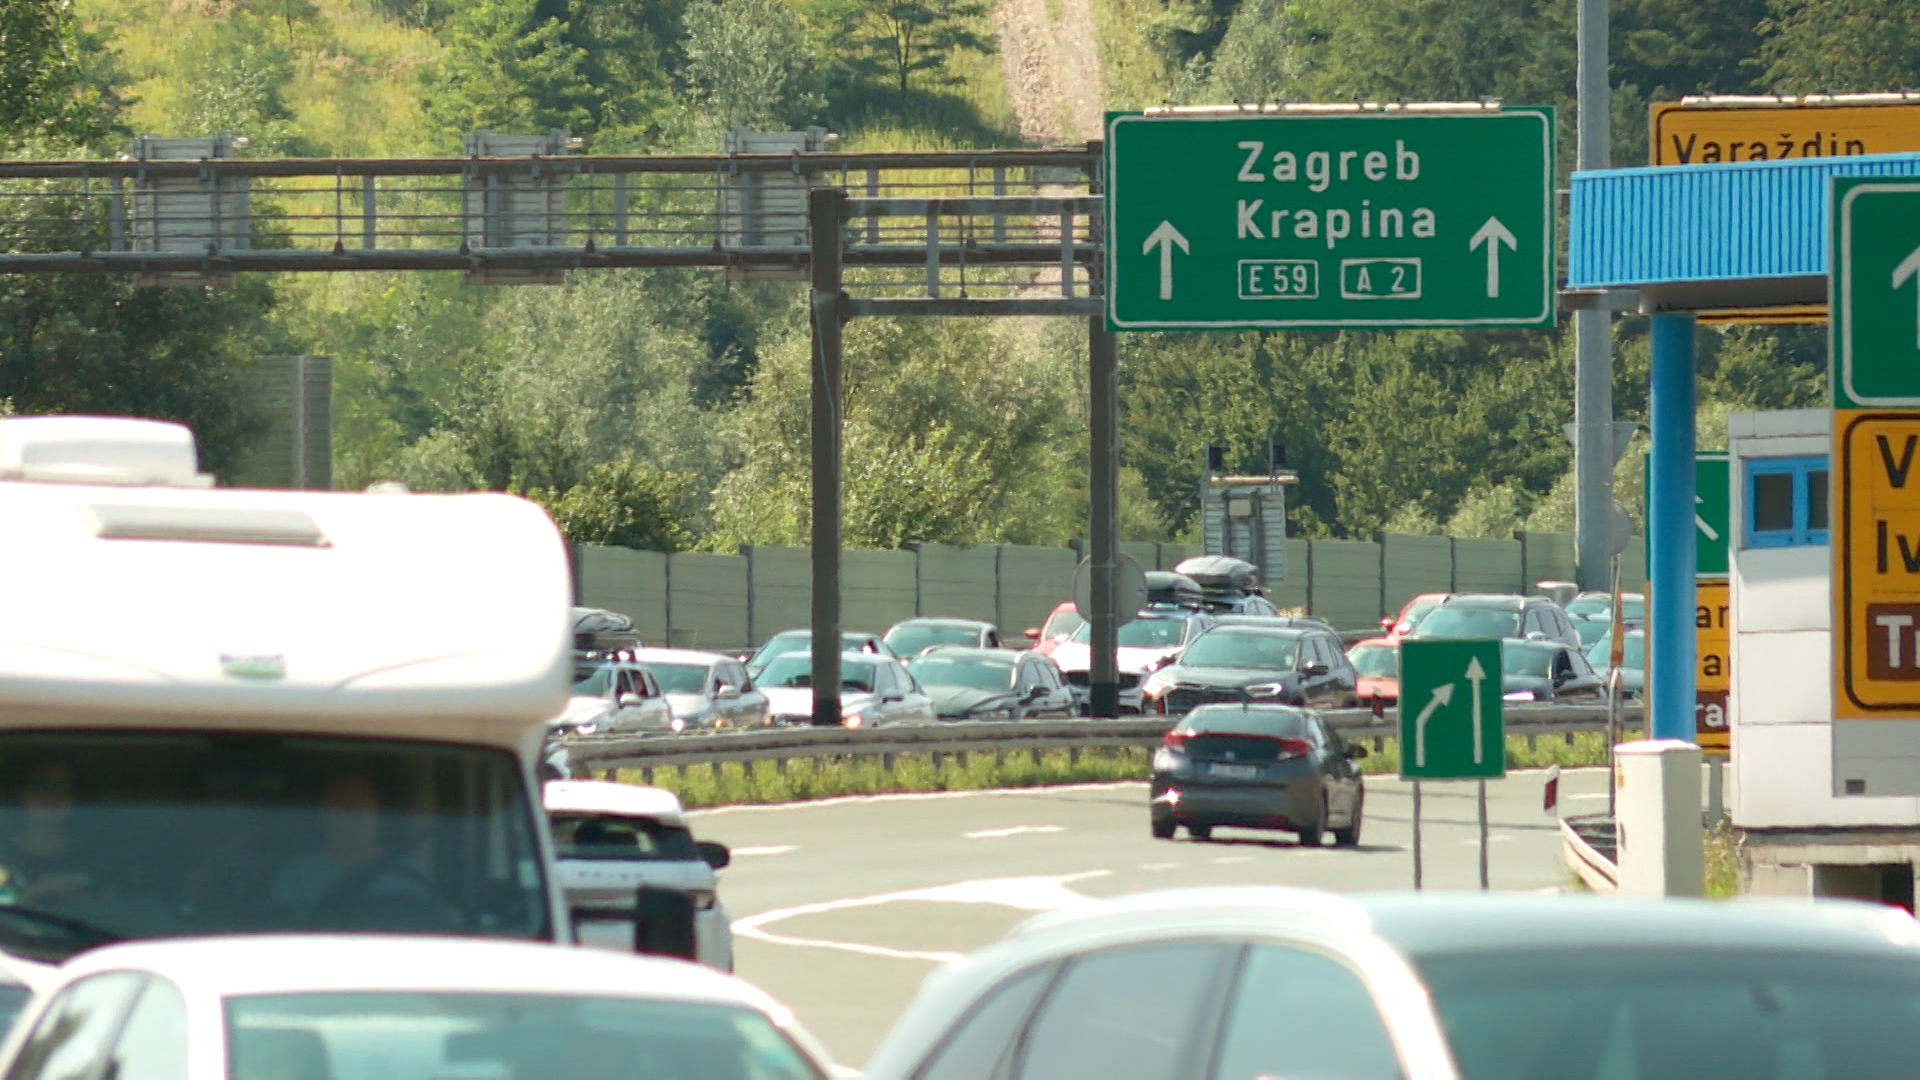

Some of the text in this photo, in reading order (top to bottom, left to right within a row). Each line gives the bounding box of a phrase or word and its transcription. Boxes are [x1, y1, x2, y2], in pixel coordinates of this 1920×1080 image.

[1237, 139, 1420, 192] Zagreb
[1672, 131, 1865, 164] Varaždin
[1237, 199, 1436, 249] Krapina
[1876, 615, 1920, 668] T
